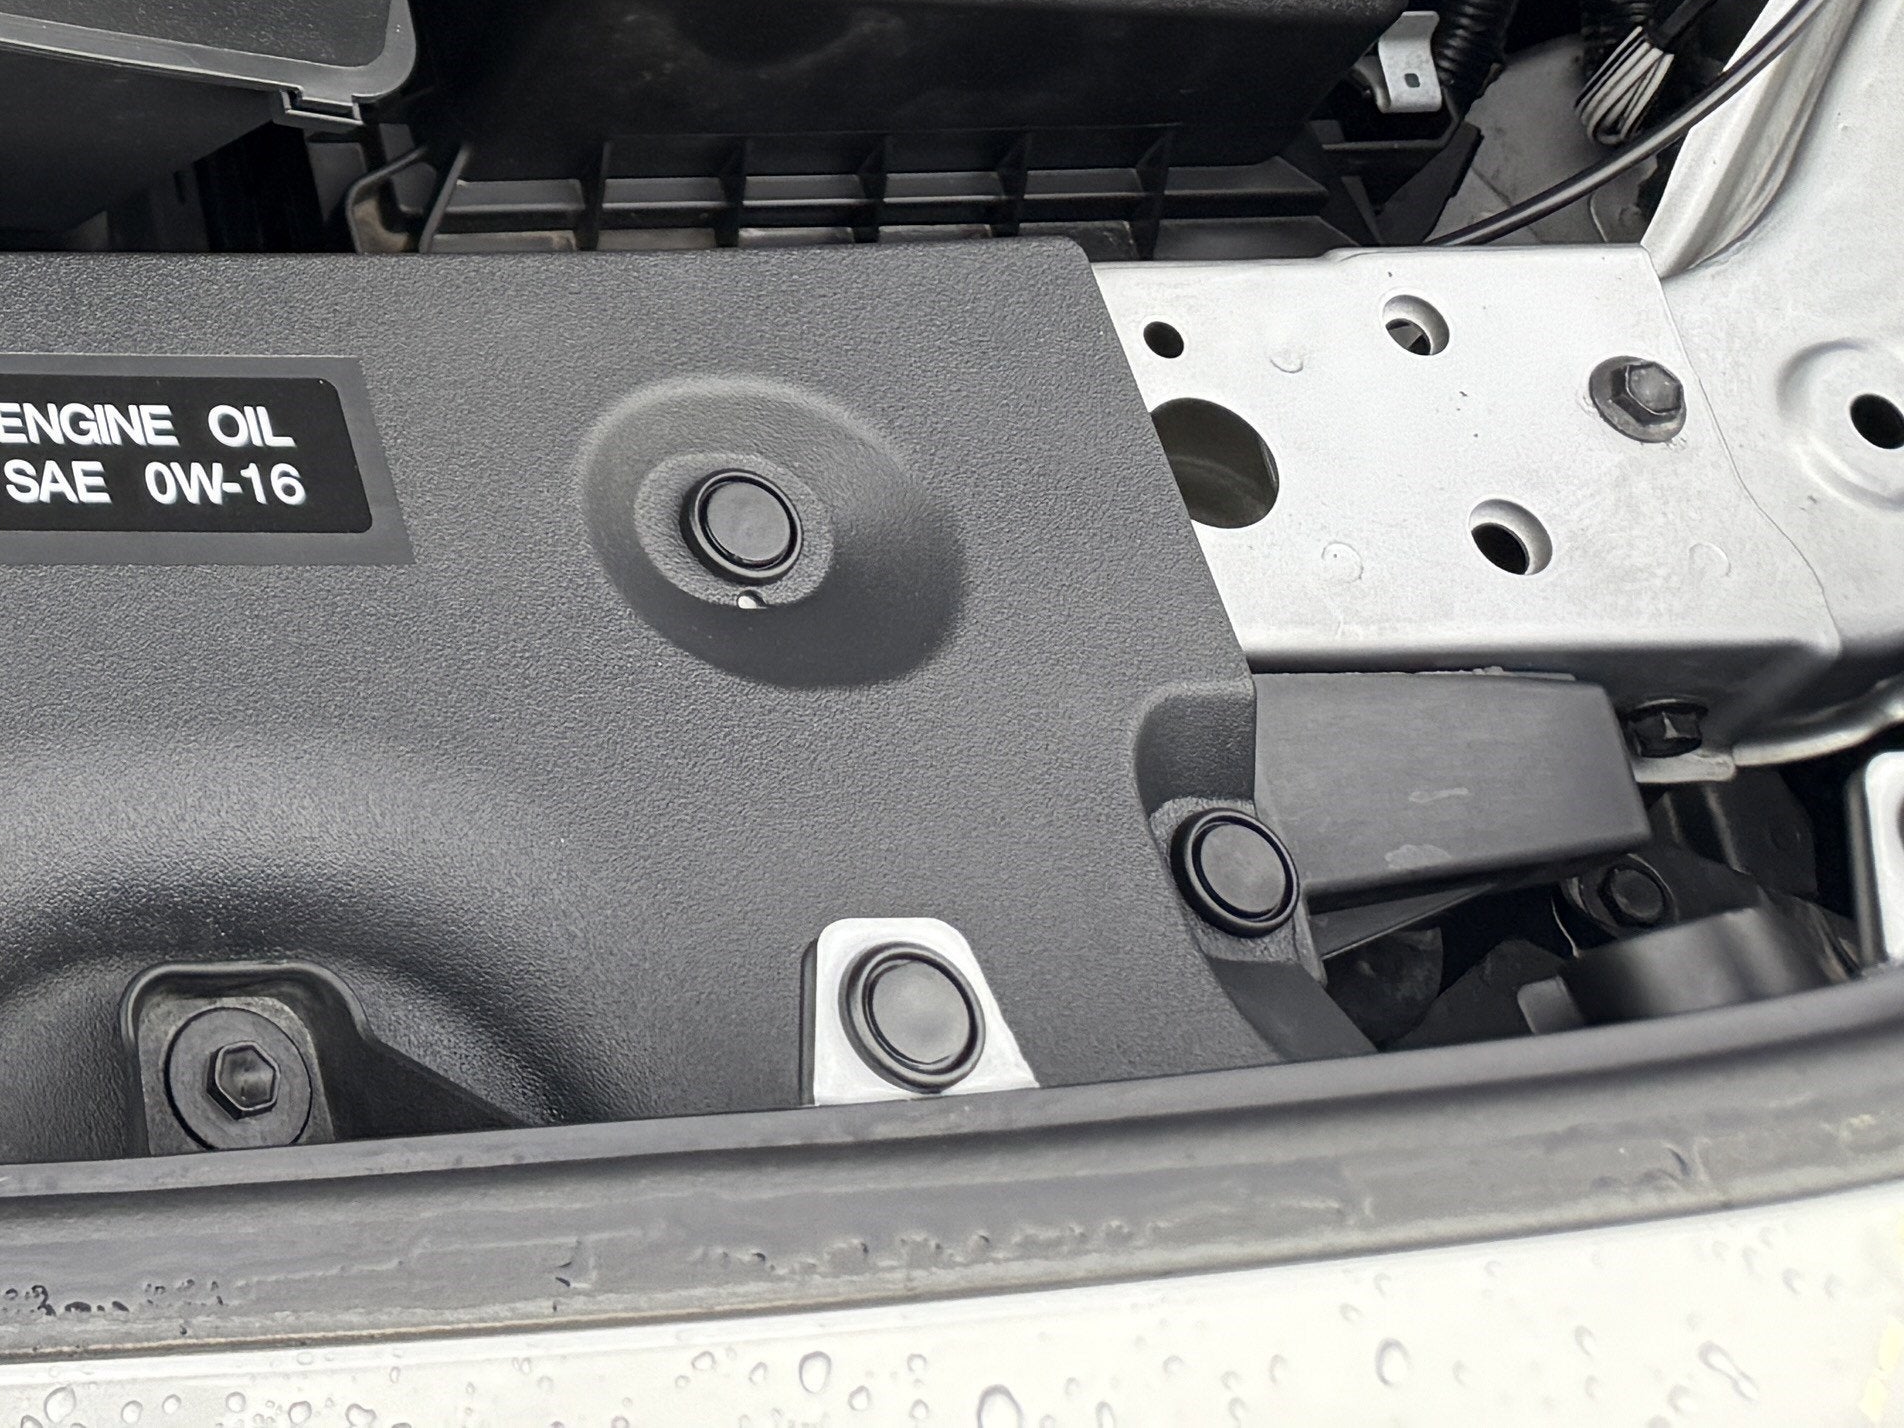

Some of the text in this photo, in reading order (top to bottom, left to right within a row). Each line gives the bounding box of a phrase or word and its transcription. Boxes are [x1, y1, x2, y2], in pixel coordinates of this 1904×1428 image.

[207, 403, 298, 448] OIL
[3, 458, 308, 506] SAE 0W-16
